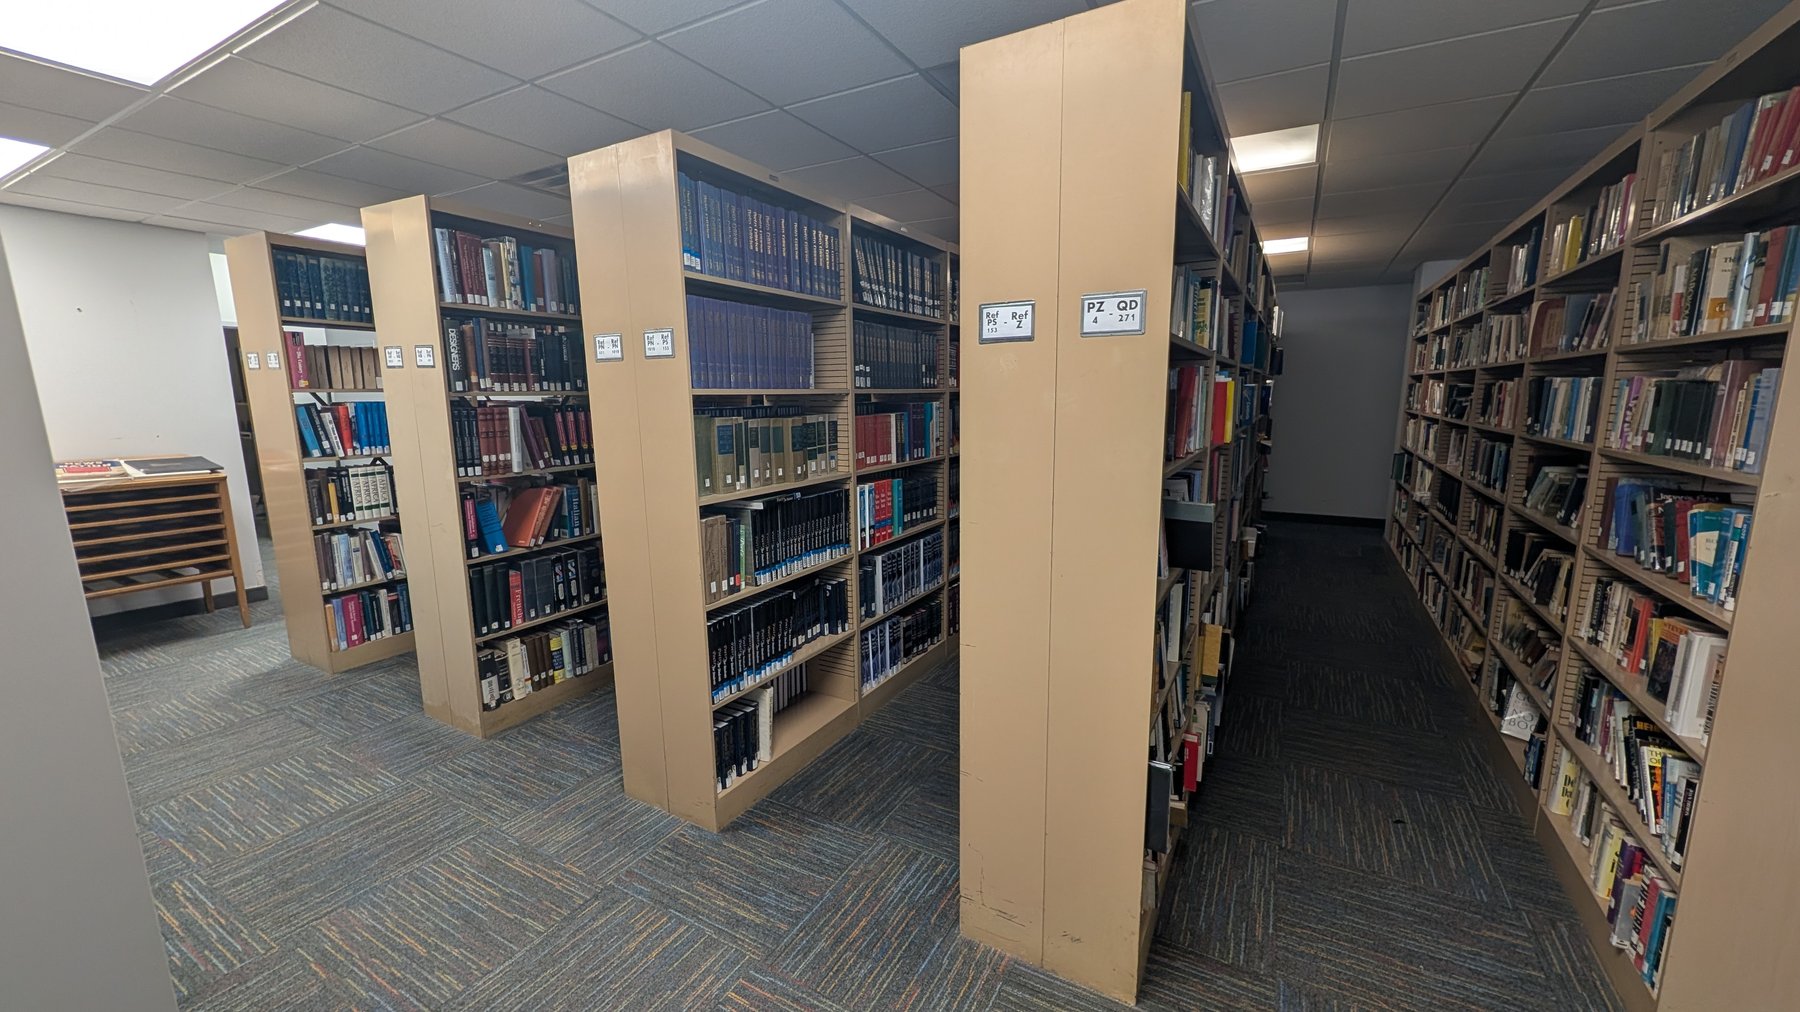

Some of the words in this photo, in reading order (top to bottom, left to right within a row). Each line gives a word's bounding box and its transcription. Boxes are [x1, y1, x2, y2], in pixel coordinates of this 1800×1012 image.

[986, 311, 999, 319] Ref
[1011, 310, 1028, 320] Ref
[1087, 301, 1105, 313] PZ
[1117, 300, 1138, 311] QD
[1016, 320, 1023, 328] Z
[1092, 316, 1098, 324] 4
[1118, 314, 1135, 322] 271
[449, 328, 460, 371] DESIGNERS
[354, 480, 362, 505] AFRICA
[363, 480, 371, 503] AFRICA
[371, 479, 379, 502] AFRICA
[379, 478, 387, 501] AFRICA
[516, 588, 524, 619] French
